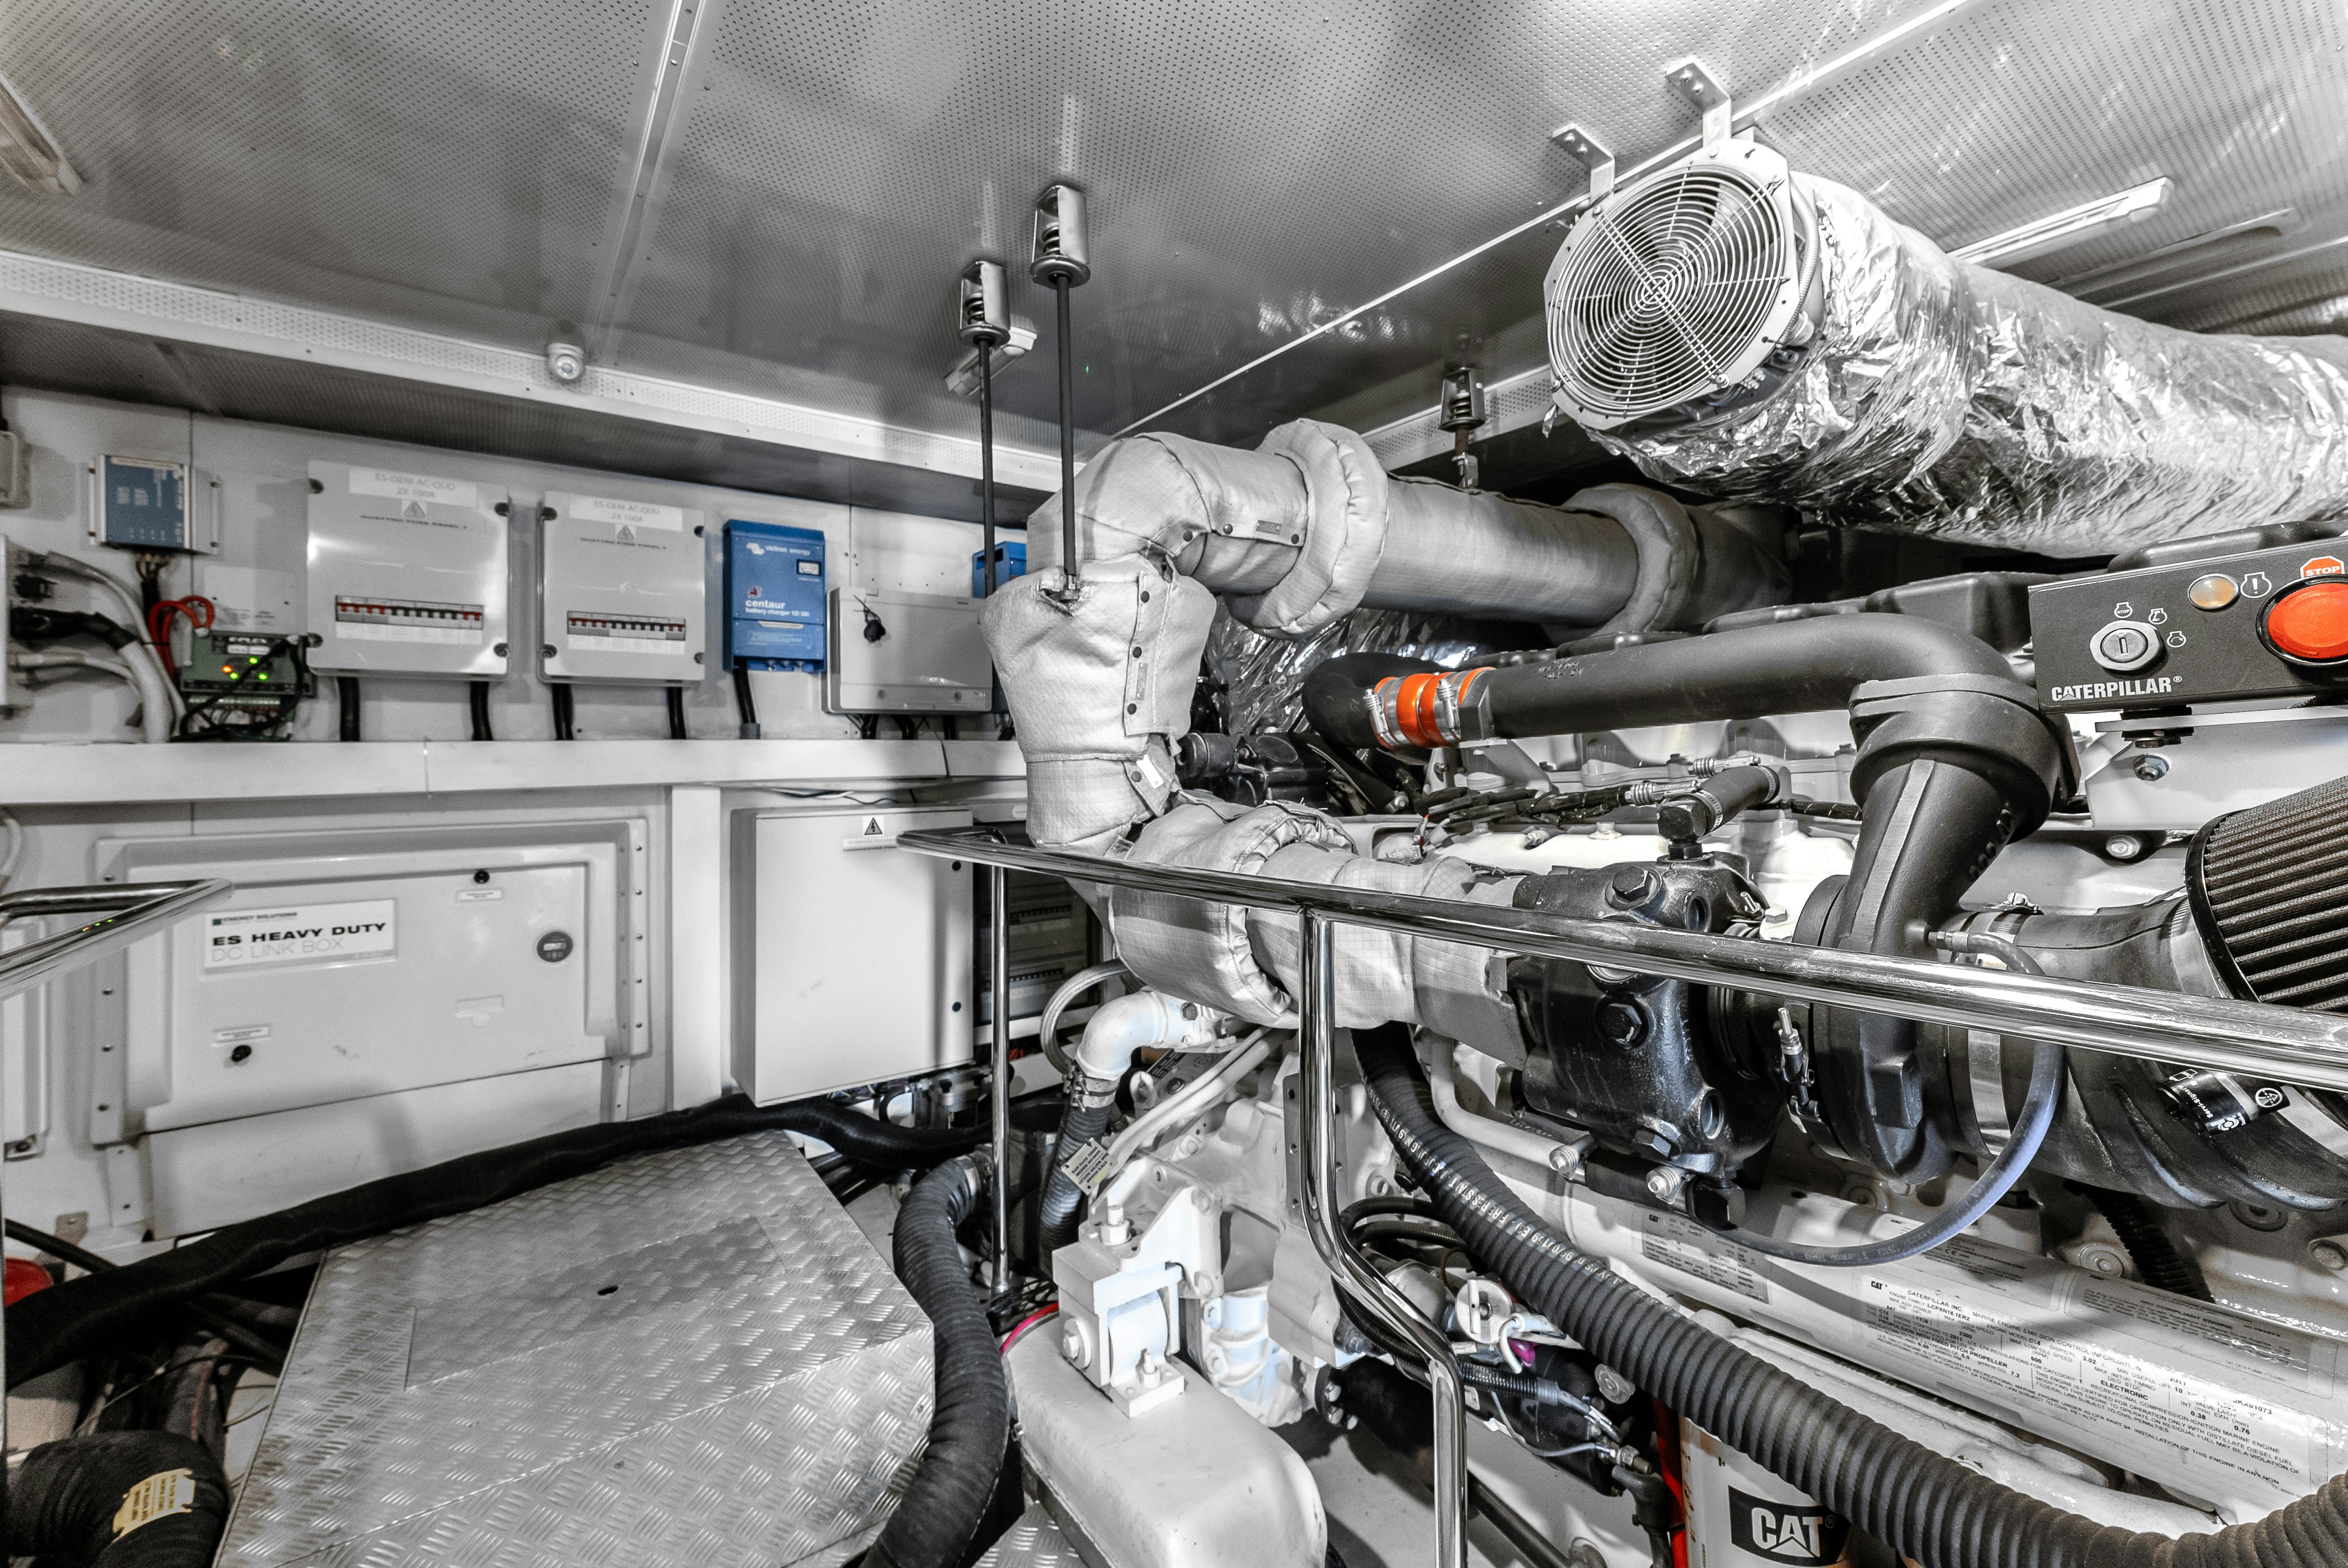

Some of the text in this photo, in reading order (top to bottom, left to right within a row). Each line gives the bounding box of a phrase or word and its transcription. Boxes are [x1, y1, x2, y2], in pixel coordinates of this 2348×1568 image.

[2305, 565, 2341, 576] STOP
[745, 599, 786, 610] centaur
[213, 922, 387, 946] ES HEAVY DUTY
[212, 937, 345, 962] DC LINK BOX
[1448, 1176, 1492, 1212] RESISTANT
[1486, 1205, 1509, 1224] FIRE
[1649, 1214, 1657, 1223] CAT
[1871, 1280, 1882, 1290] CAT
[1889, 1290, 1906, 1300] ENGINE
[1913, 1304, 1932, 1314] POWER
[1908, 1289, 1949, 1307] CATERPILLAR
[1951, 1303, 1964, 1312] INC.
[1973, 1311, 1995, 1323] MARINE
[1998, 1319, 2021, 1332] ENGINE
[2023, 1327, 2054, 1343] EMISSION
[2057, 1338, 2089, 1354] CONTROL
[1976, 1325, 1994, 1335] SPEED
[1878, 1317, 1914, 1334] PROPULSION
[1915, 1330, 1930, 1340] WITH
[1932, 1337, 1948, 1347] FIXED
[1950, 1343, 1968, 1354] PITCH
[1970, 1350, 2007, 1368] PROPELLER
[1918, 1327, 1944, 1340] CERTIFIED
[1987, 1323, 2096, 1364] ENGINE MODEL 3.02
[1877, 1337, 1912, 1353] RECREATIONAL
[1914, 1350, 1932, 1360] VESSEL
[2025, 1342, 2037, 1350] LOW
[2053, 1352, 2072, 1363] SPEED
[2032, 1349, 2048, 1359] (RPM)
[1893, 1313, 1911, 1324] ENGINE
[1949, 1333, 1962, 1342] 2011
[1990, 1348, 2029, 1365] REGULATIONS
[2030, 1362, 2042, 1370] FOR
[2043, 1366, 2074, 1381] CATEGORY
[2090, 1383, 2138, 1404] RECREATIONAL
[2140, 1401, 2221, 1433] COMPRESSION-IGNITION
[2223, 1429, 2249, 1443] MARINE
[2252, 1440, 2279, 1454] ENGINE
[1980, 1375, 2043, 1402] FEDERAL SUBJECT
[2100, 1379, 2148, 1400] ELECTRONIC
[2133, 1379, 2155, 1391] TIMING
[2036, 1381, 2063, 1395] FEDERAL
[2064, 1391, 2077, 1400] LAW
[2078, 1396, 2104, 1410] SUBJECT
[2117, 1410, 2133, 1420] CIVIL
[2195, 1400, 2215, 1411] VALVE
[1903, 1342, 1922, 1353] ENGINE
[1928, 1351, 1964, 1368] CATEGORIZED
[1973, 1368, 2013, 1386] RECREATIONAL
[2015, 1384, 2036, 1395] MARINE
[2038, 1392, 2059, 1404] ENGINE
[2061, 1401, 2082, 1412] UNDER
[2092, 1412, 2104, 1420] CFR
[2106, 1417, 2122, 1427] PART
[2134, 1427, 2178, 1448] INSTALLATION
[2191, 1448, 2206, 1458] THIS
[2209, 1454, 2235, 1469] ENGINE
[2263, 1474, 2279, 1485] NON
[2036, 1370, 2293, 1466] THIS ENGINE CERTIFIED FOR OPERATION ONLY WITH DISTILLATE DIESEL FUEL
[2036, 1375, 2069, 1392] MODIFYING
[2071, 1388, 2084, 1397] THIS
[2086, 1394, 2107, 1406] ENGINE
[2120, 1406, 2149, 1421] OPERATE
[2162, 1421, 2196, 1437] RESIDUAL
[2197, 1433, 2215, 1444] FUEL
[2216, 1440, 2231, 1450] MAY
[2251, 1453, 2288, 1471] VIOLATION
[2191, 1410, 2206, 1420] 0.38
[2195, 1405, 2210, 1415] (mm)
[2214, 1412, 2228, 1421] EXH
[2232, 1418, 2249, 1428] (mm)
[2234, 1425, 2249, 1435] 0.76
